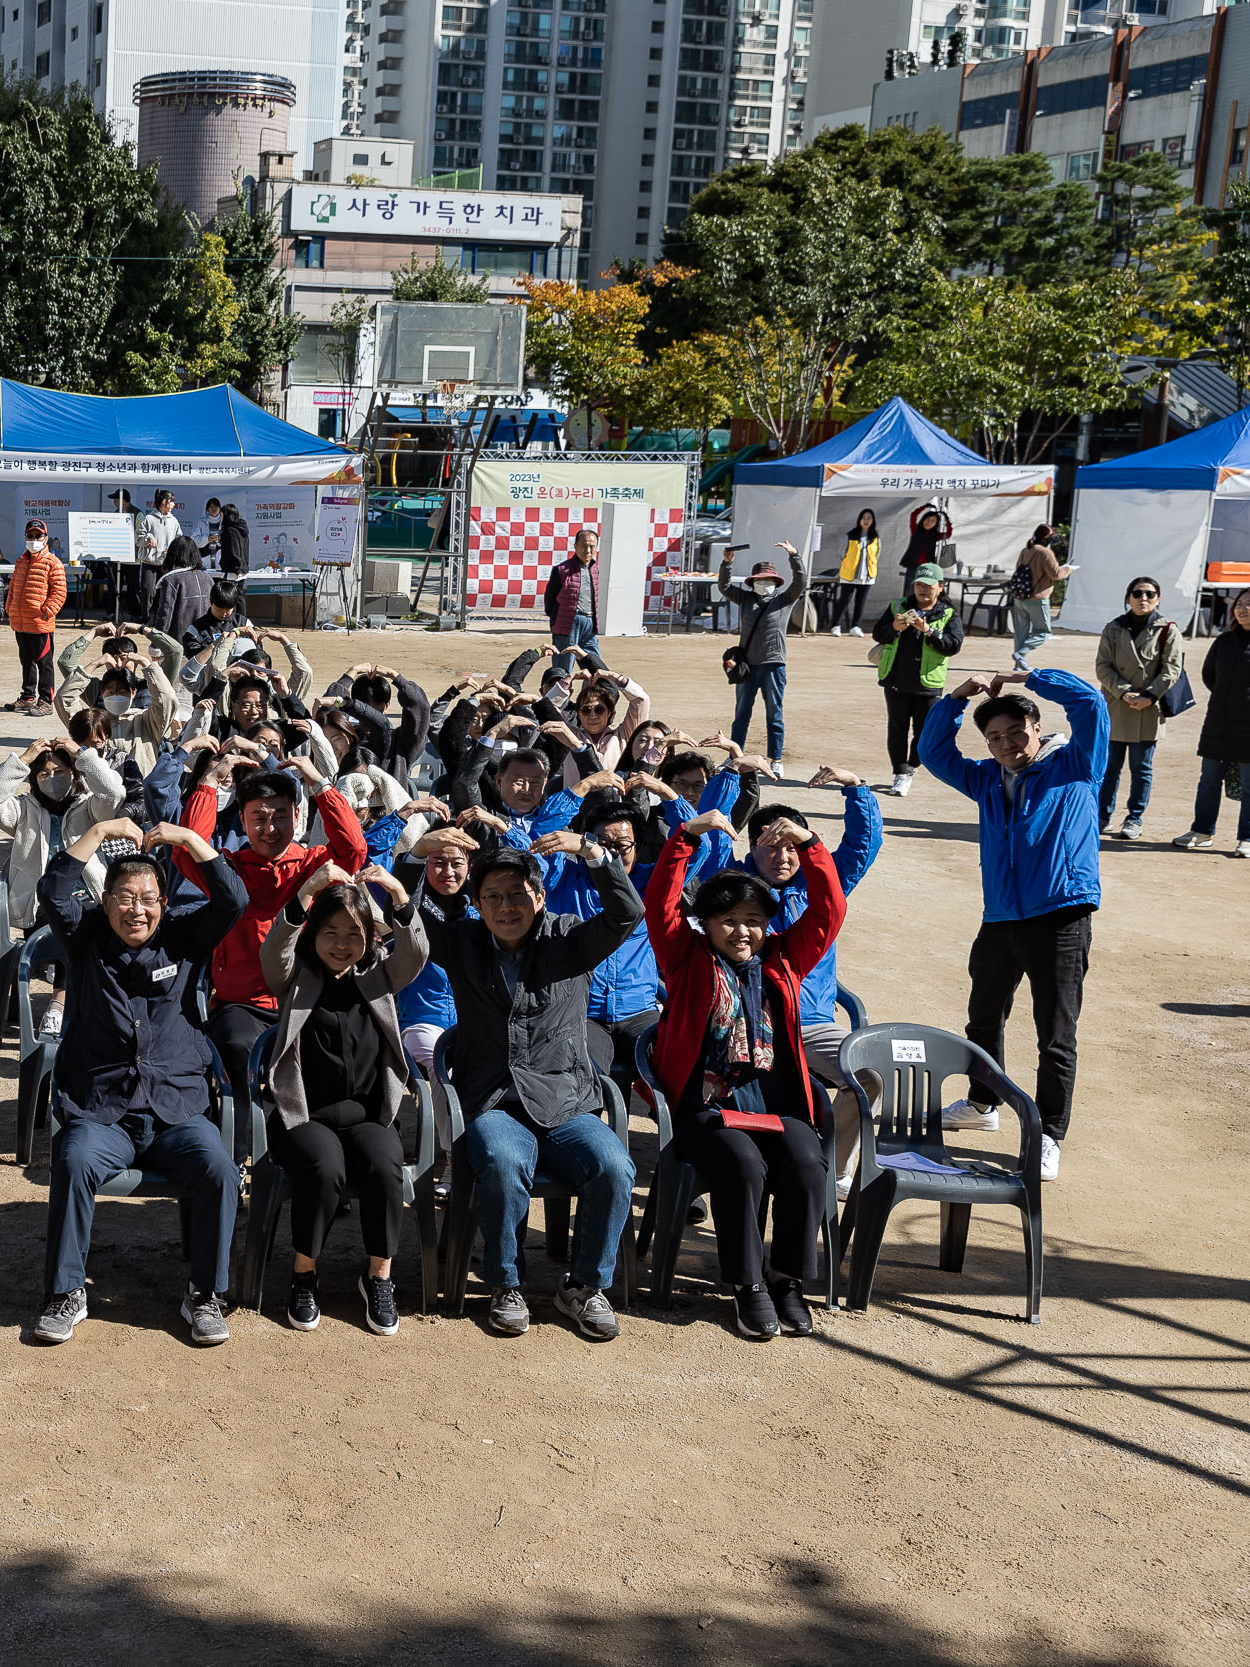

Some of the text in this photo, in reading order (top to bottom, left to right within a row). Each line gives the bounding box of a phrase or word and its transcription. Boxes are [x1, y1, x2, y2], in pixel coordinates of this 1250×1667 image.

[347, 197, 544, 226] 사랑 가득한 치과
[26, 459, 58, 471] 행복할
[60, 460, 92, 473] 광진구
[95, 461, 137, 473] 청소년과
[140, 462, 193, 474] 함께합니다
[509, 473, 541, 483] 2023년
[879, 477, 900, 489] 우리
[903, 478, 944, 490] 가족사진
[947, 478, 967, 490] 액자
[509, 486, 534, 499] 광진
[597, 487, 645, 500] 가족축제
[255, 511, 283, 520] 지원사업
